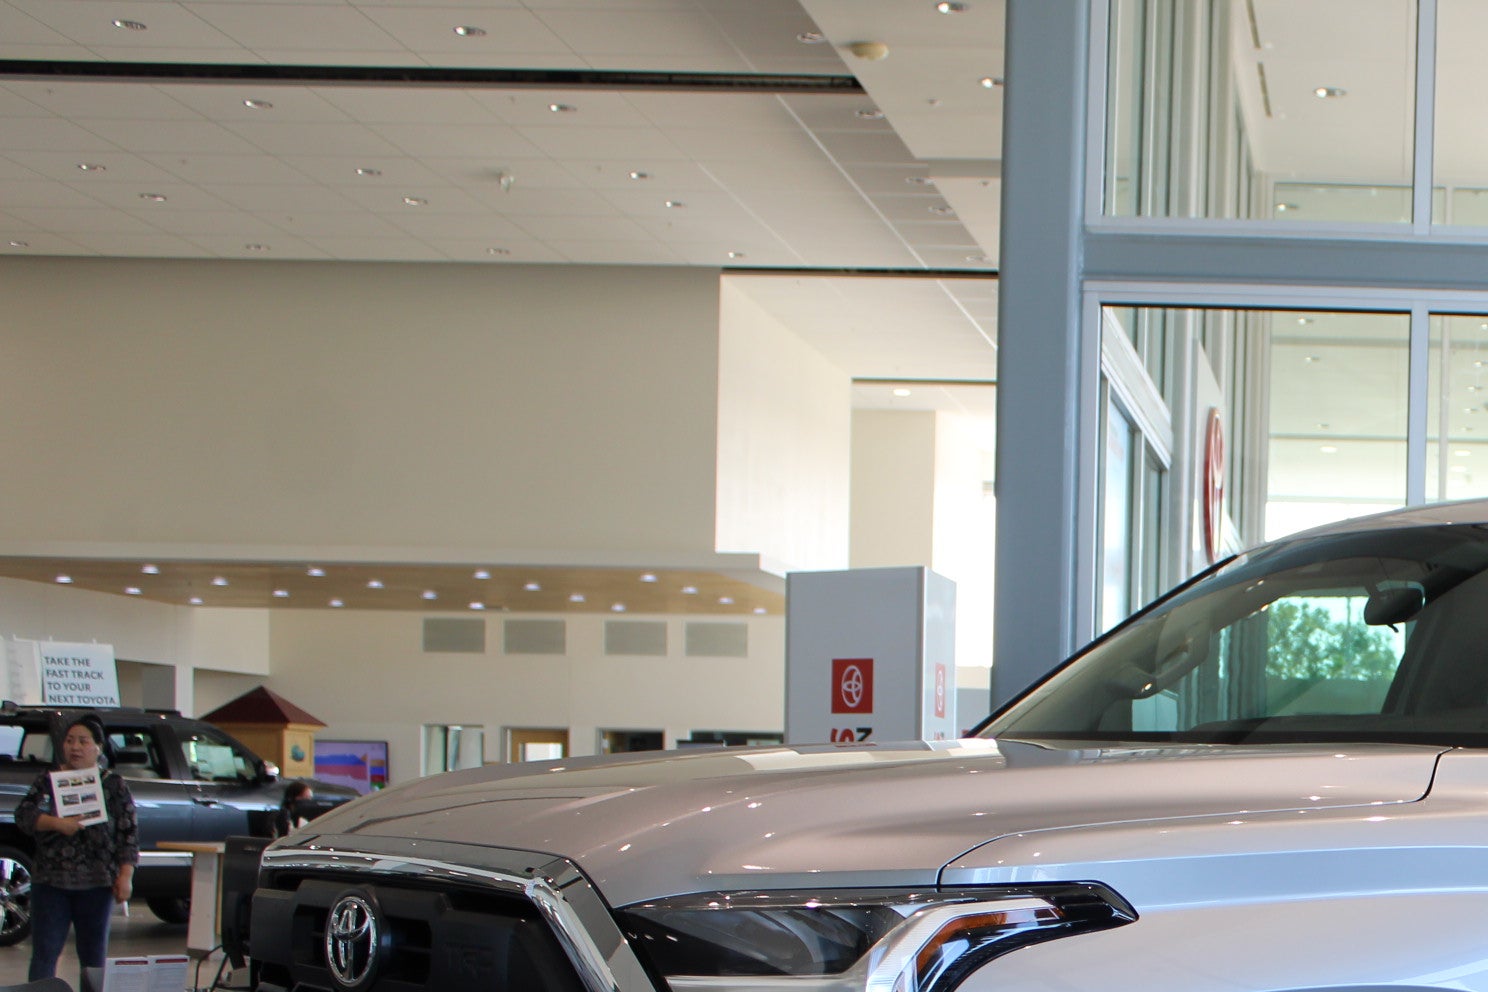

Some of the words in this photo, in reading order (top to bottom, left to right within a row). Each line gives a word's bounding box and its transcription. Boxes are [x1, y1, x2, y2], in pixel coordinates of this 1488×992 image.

[44, 656, 69, 666] TAKE
[72, 657, 91, 667] THE
[46, 669, 69, 678] FAST
[71, 670, 104, 680] TRACK
[47, 682, 61, 690] TO
[63, 682, 92, 692] YOUR
[49, 694, 74, 703] NEXT
[77, 695, 116, 704] TOYOTA
